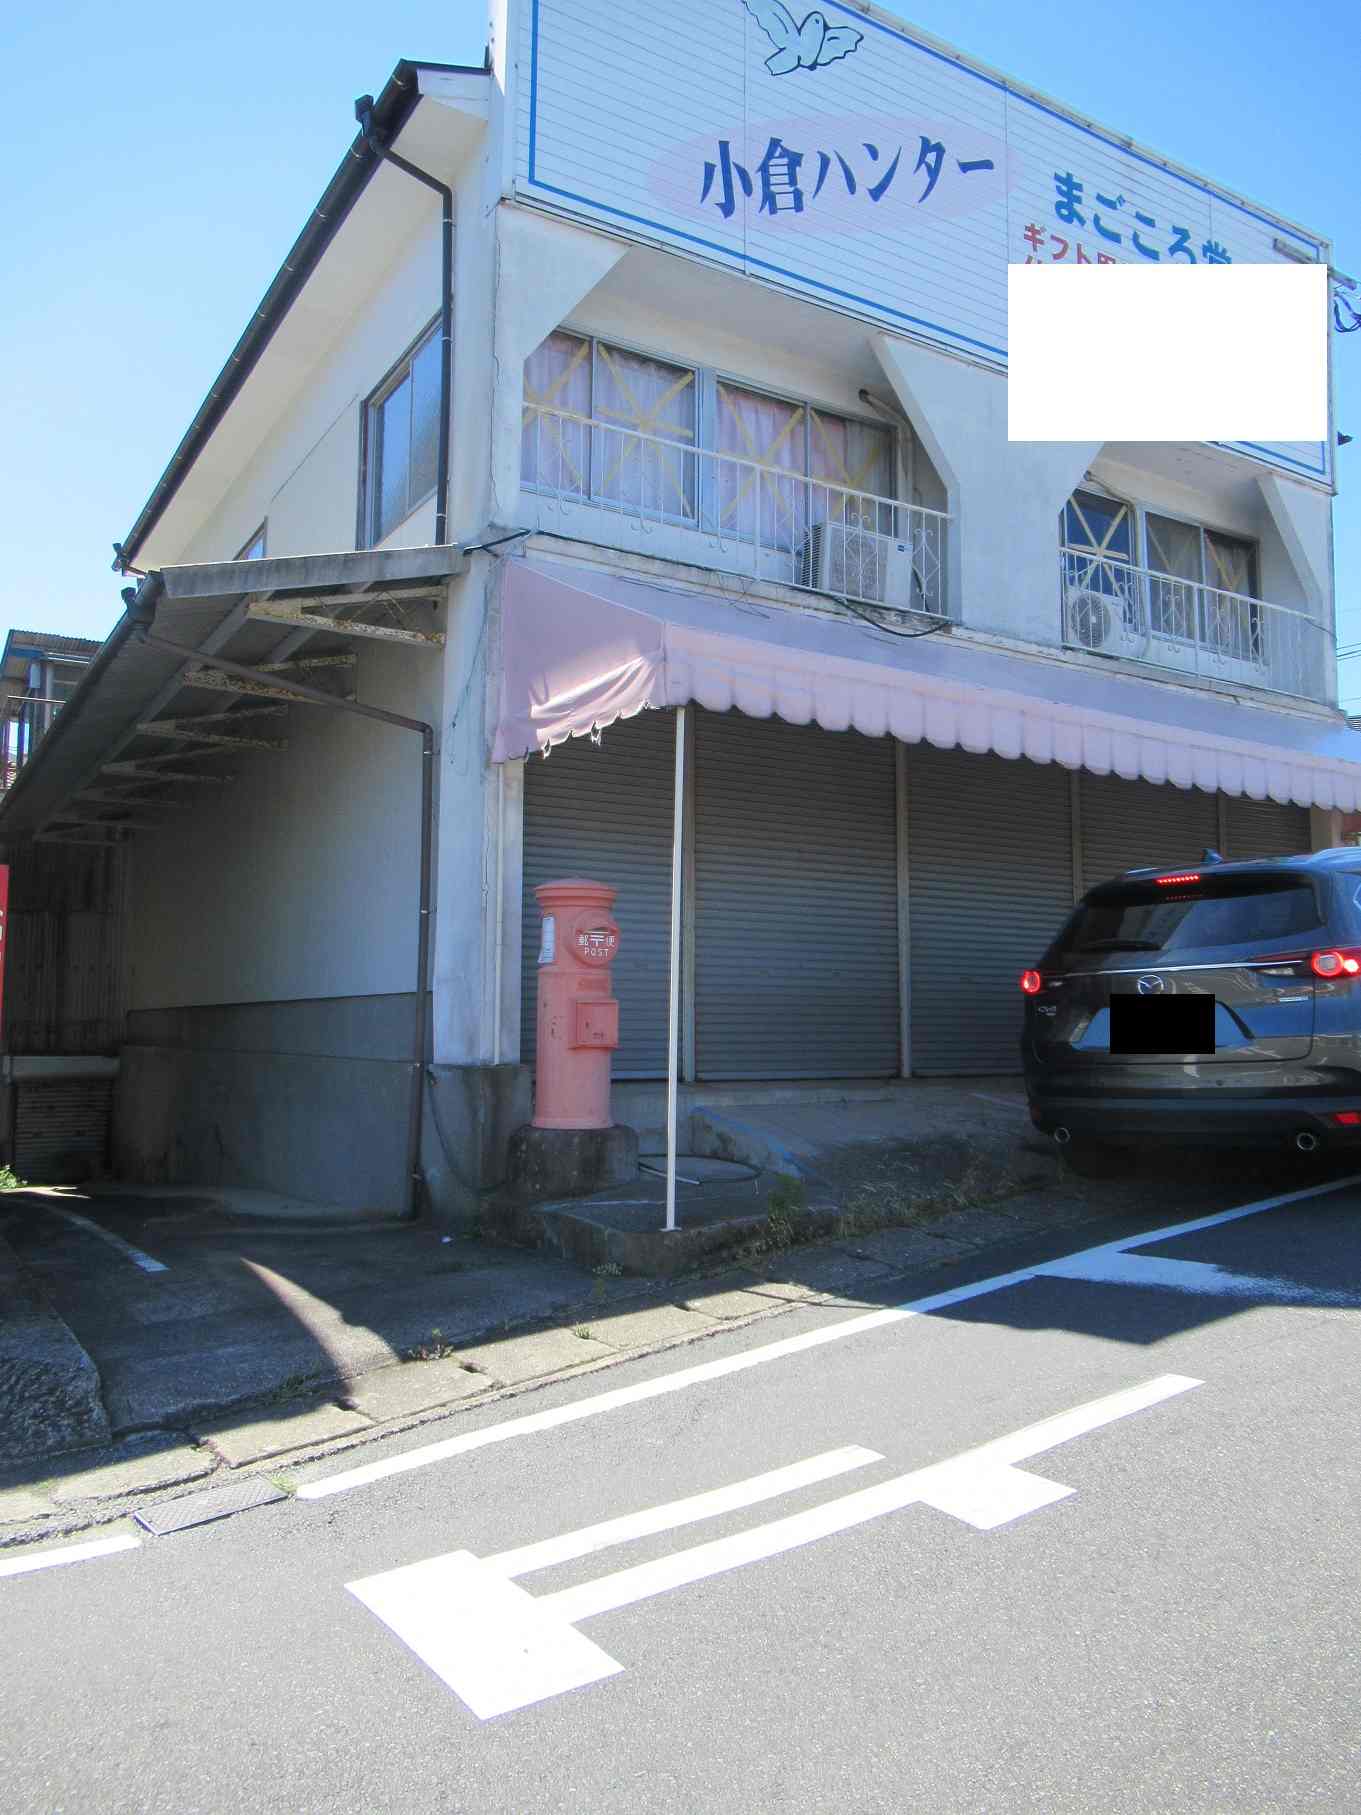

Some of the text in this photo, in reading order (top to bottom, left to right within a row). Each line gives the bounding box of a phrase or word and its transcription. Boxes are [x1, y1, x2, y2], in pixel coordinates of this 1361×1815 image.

[700, 136, 995, 219] 小倉ハンター
[584, 948, 609, 958] POST
